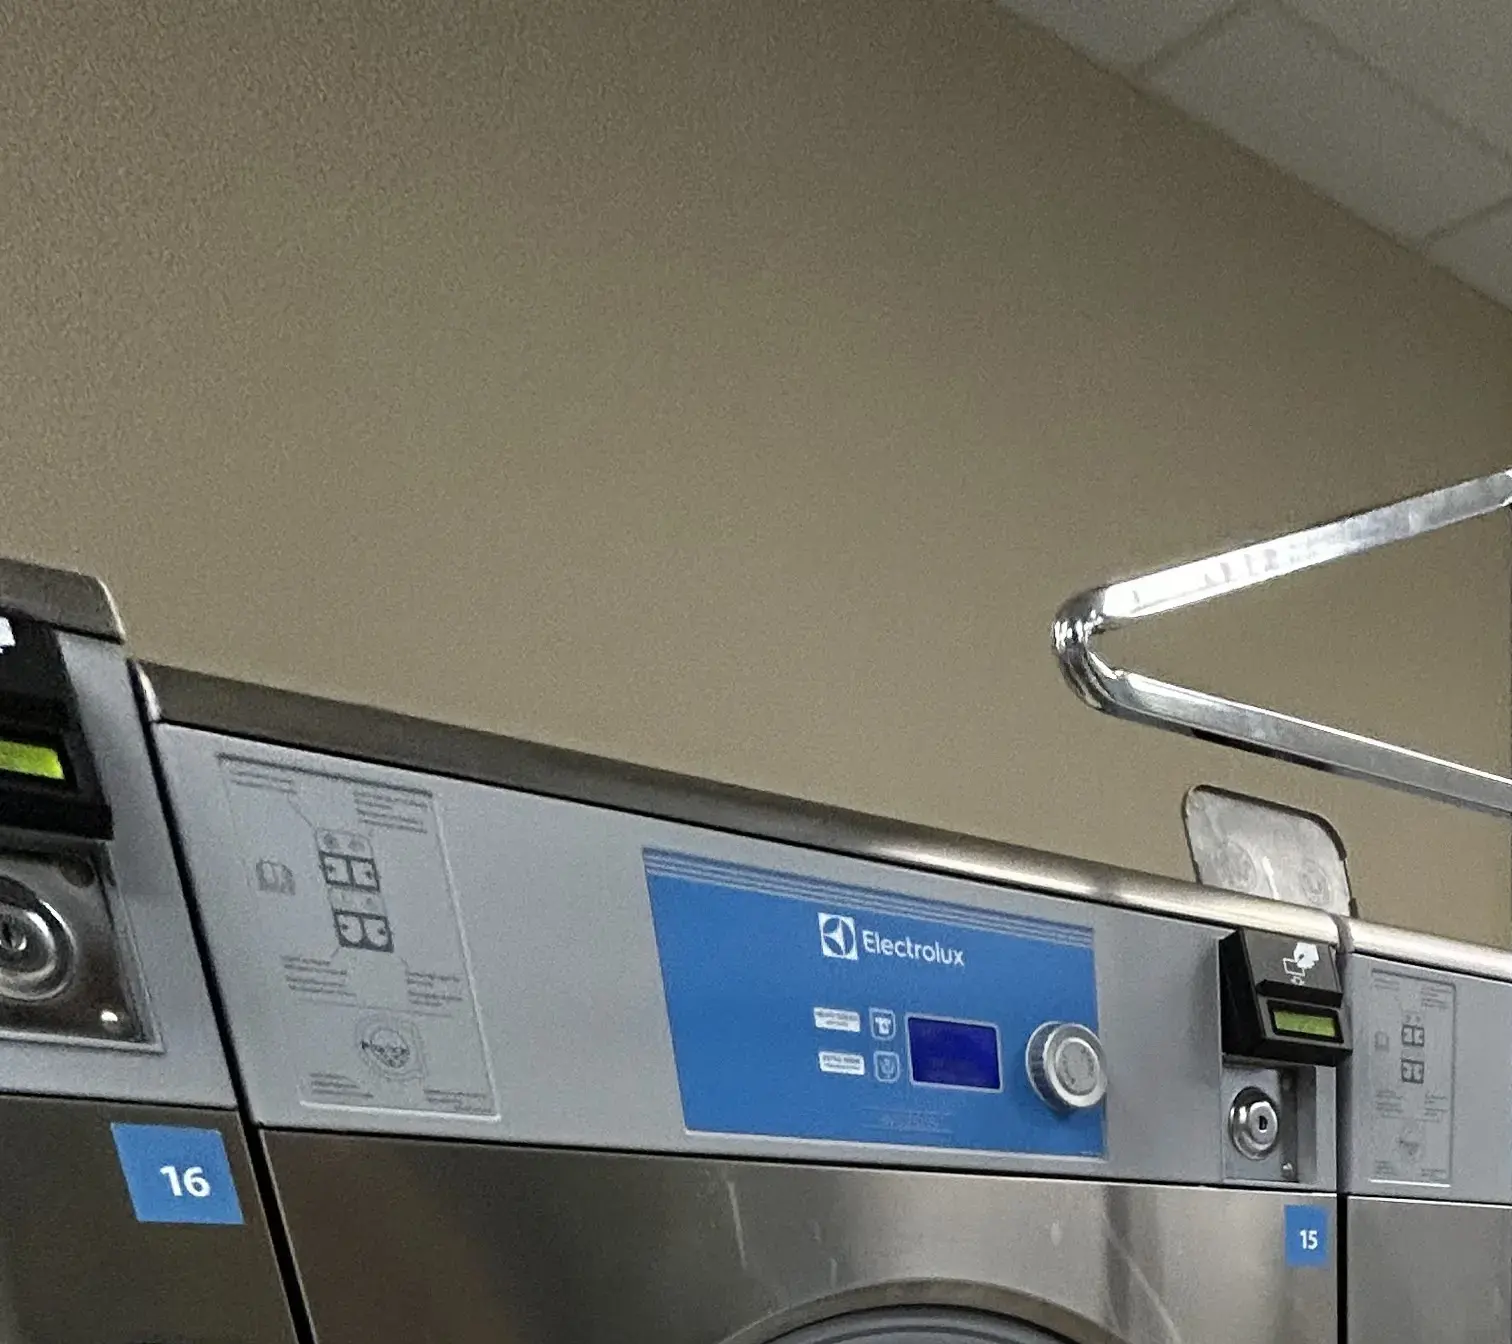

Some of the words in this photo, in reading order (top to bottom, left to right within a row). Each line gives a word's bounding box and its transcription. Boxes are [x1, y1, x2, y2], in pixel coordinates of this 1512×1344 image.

[862, 930, 965, 967] Electrolux
[159, 1165, 212, 1198] 16
[1299, 1229, 1319, 1250] 15
